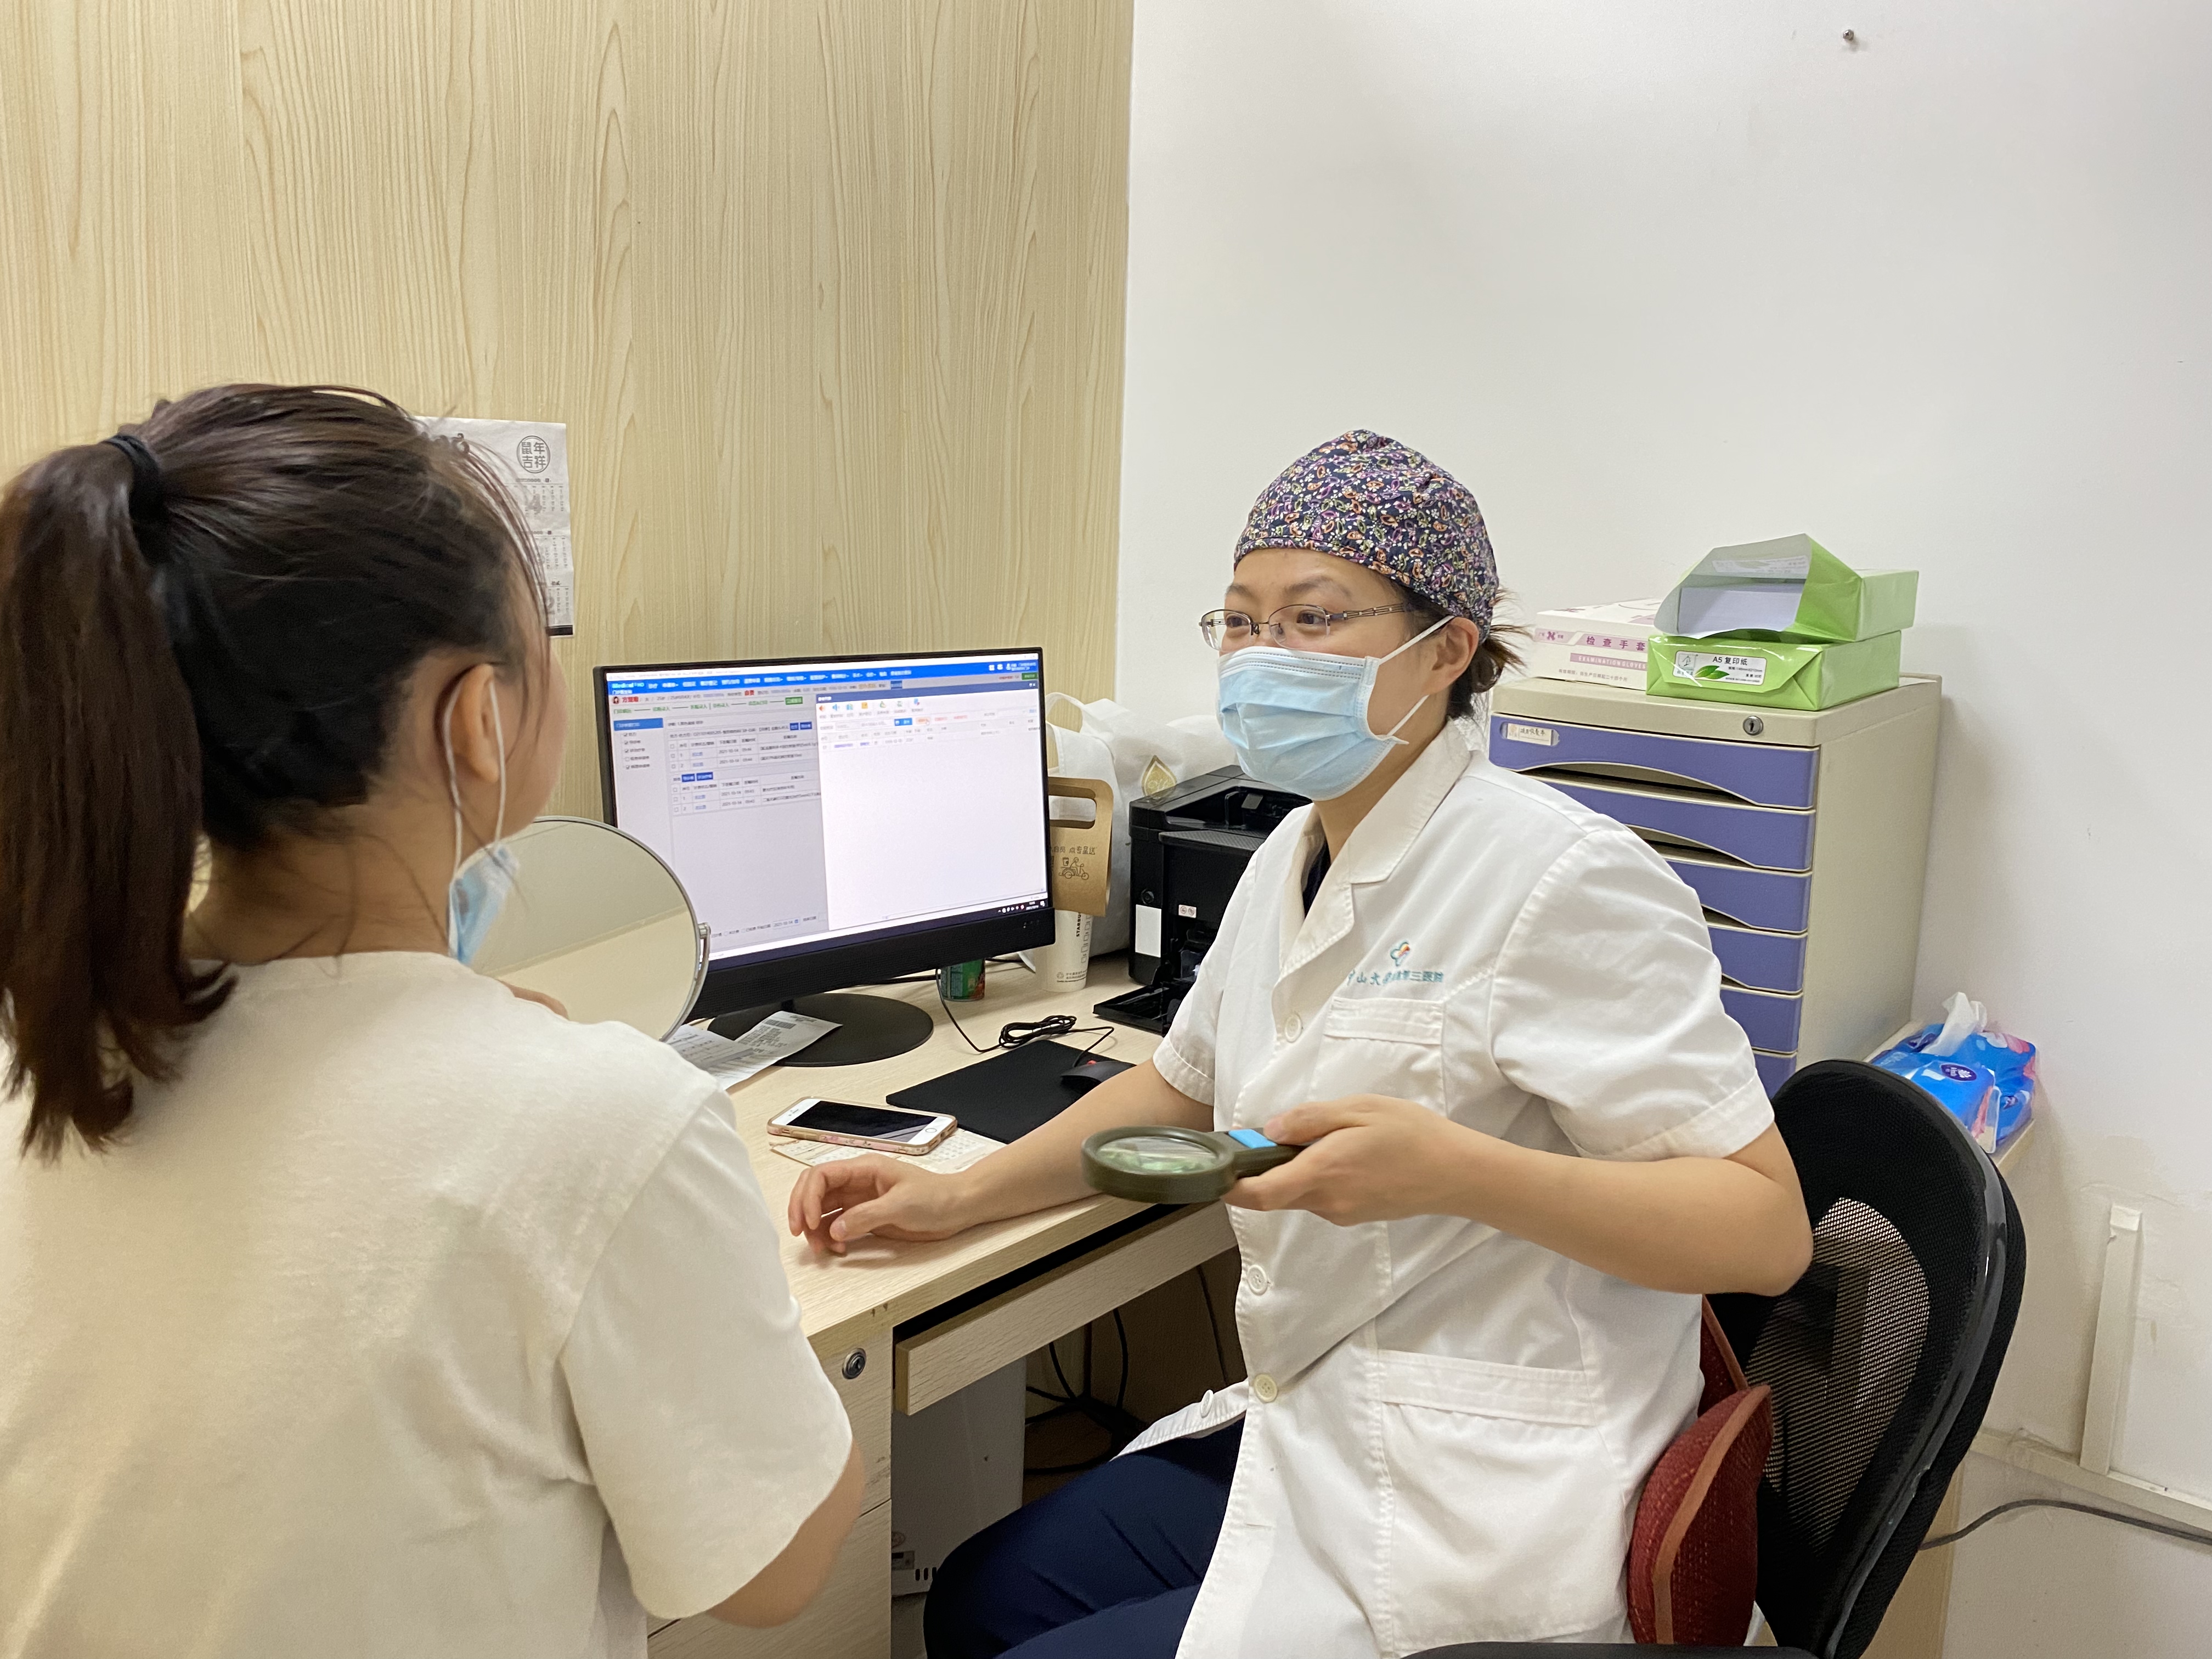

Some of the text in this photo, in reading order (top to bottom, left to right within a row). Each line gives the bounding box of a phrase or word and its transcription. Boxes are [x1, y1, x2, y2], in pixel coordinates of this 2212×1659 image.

[521, 442, 545, 454] 鼠年
[522, 455, 546, 468] 吉祥
[1586, 636, 1645, 651] 检查手套
[1578, 656, 1621, 666] EXAMINATION
[1724, 657, 1747, 665] 复印纸
